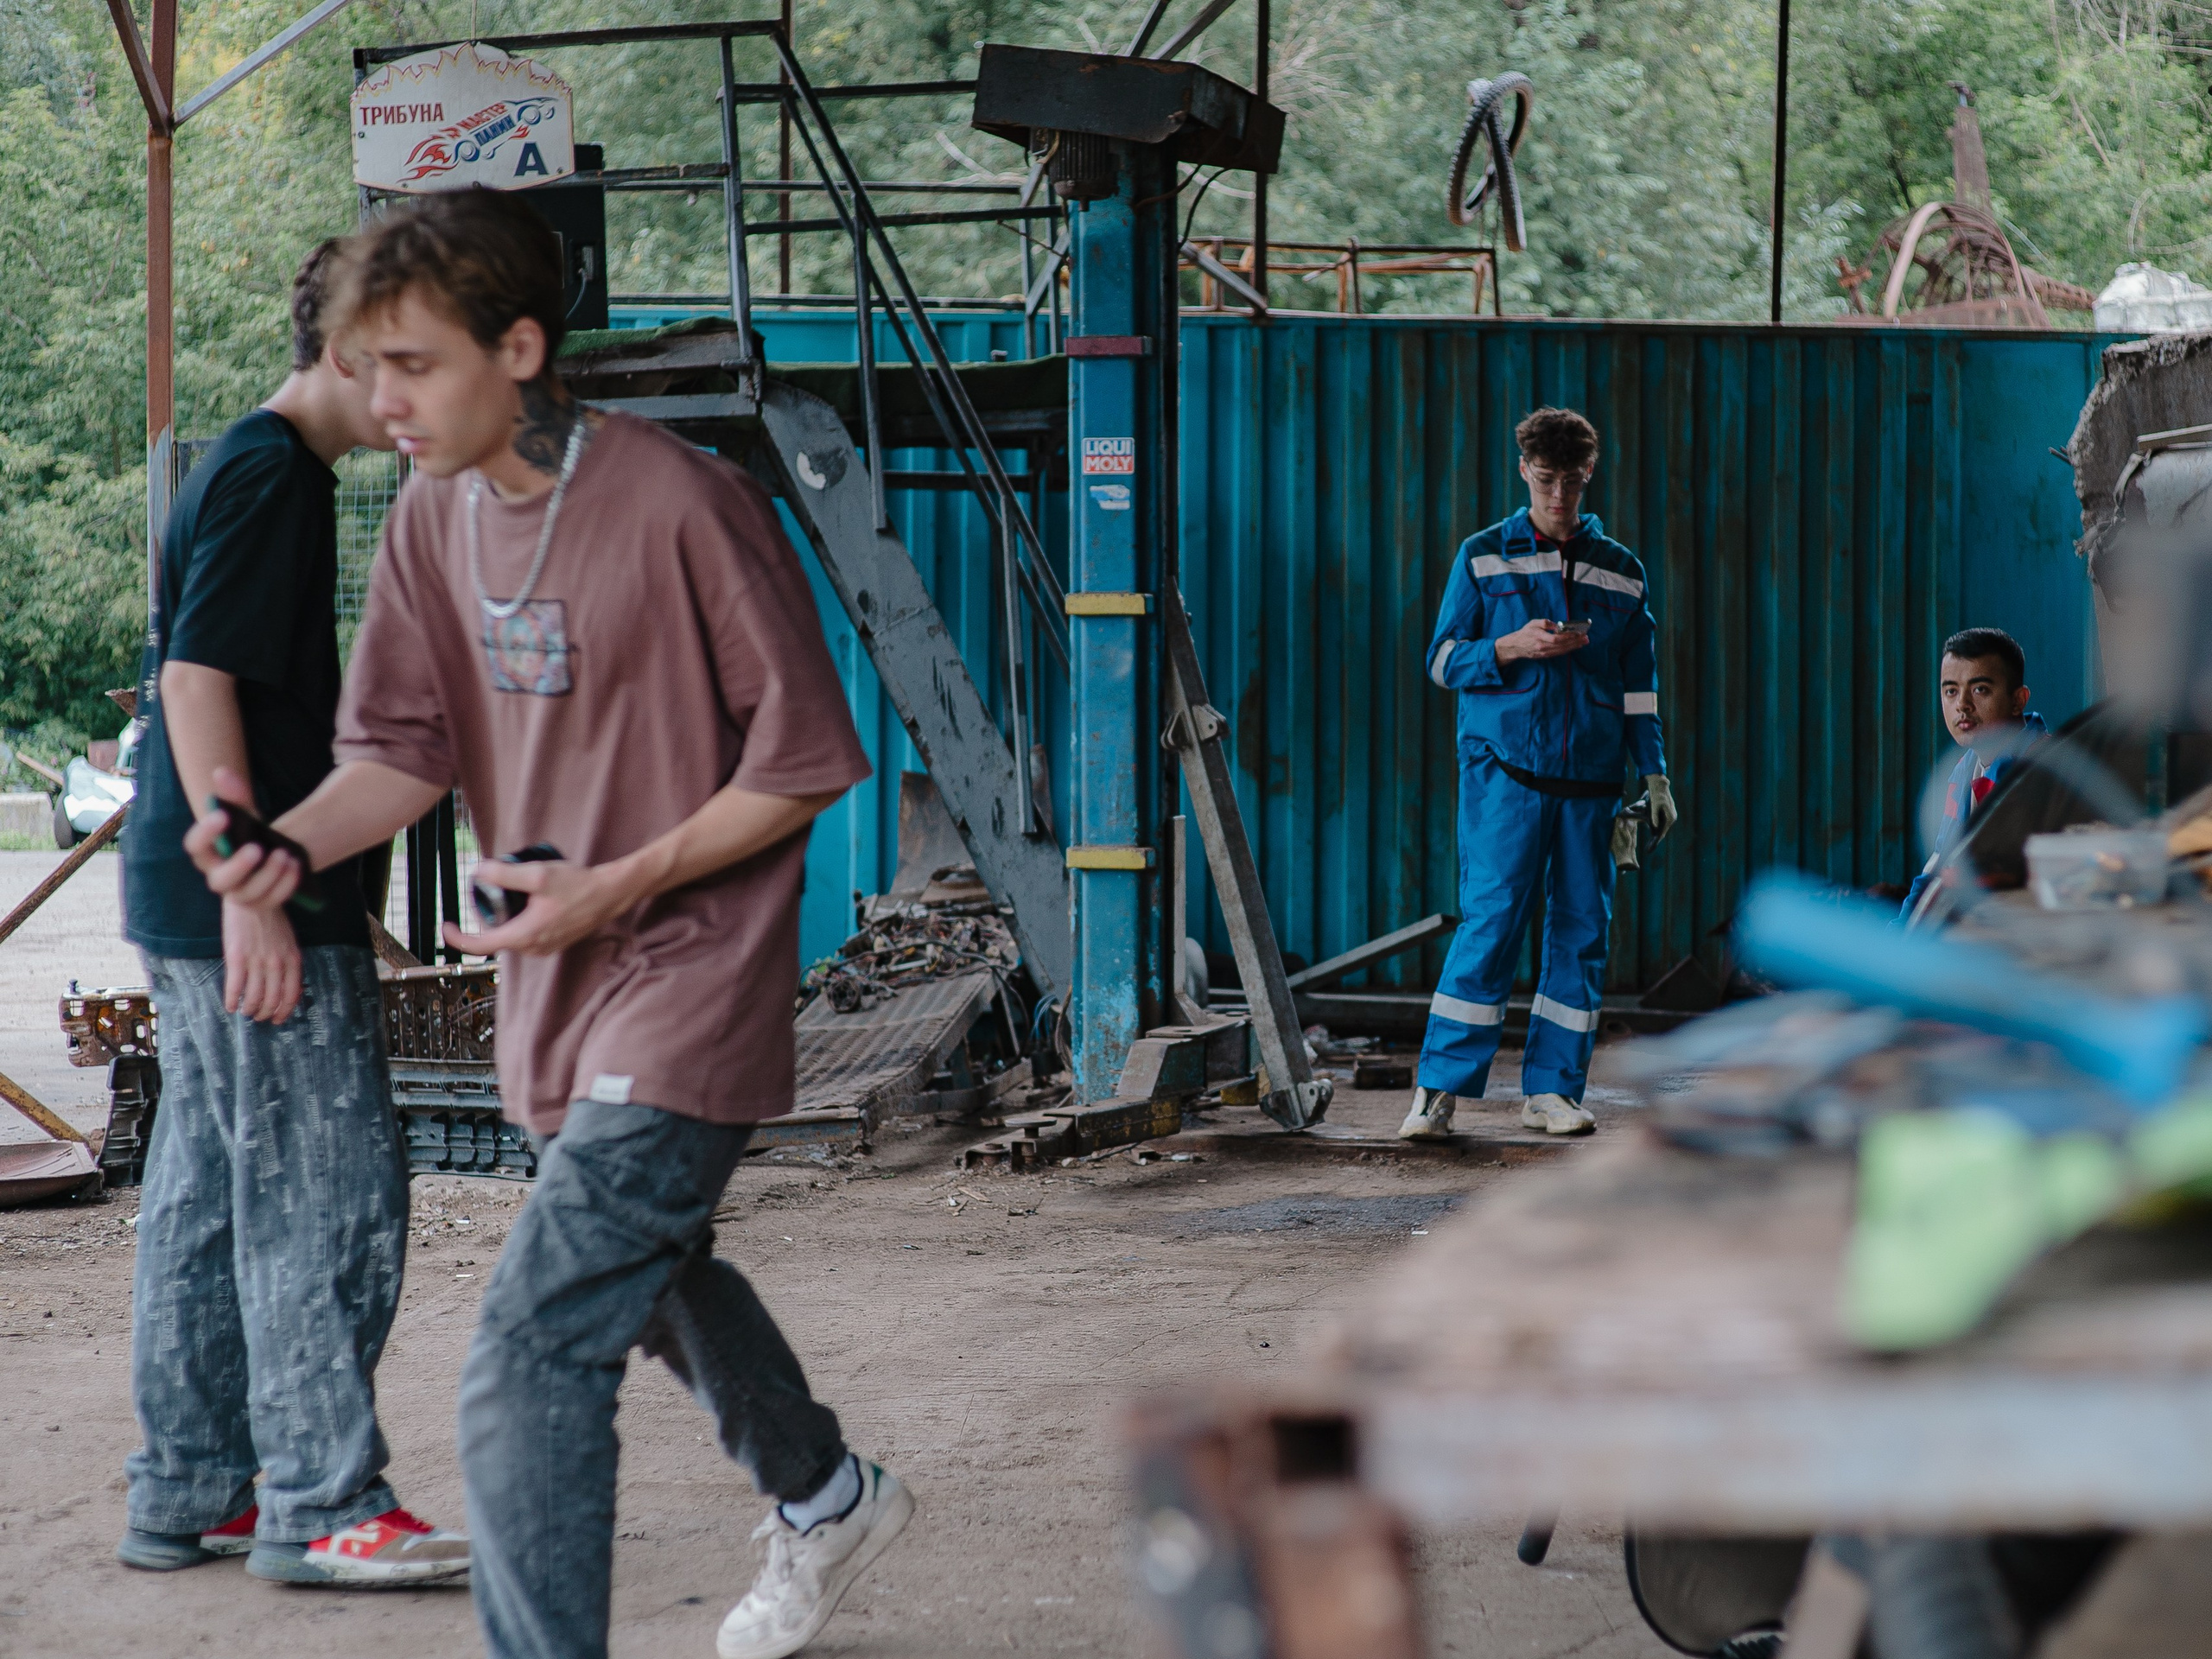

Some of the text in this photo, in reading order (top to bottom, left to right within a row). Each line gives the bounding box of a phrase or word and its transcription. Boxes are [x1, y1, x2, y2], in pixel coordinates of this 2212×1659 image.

[359, 103, 444, 126] ТРИБУНА
[1086, 440, 1132, 455] LIQUI
[1086, 456, 1132, 471] MOLY
